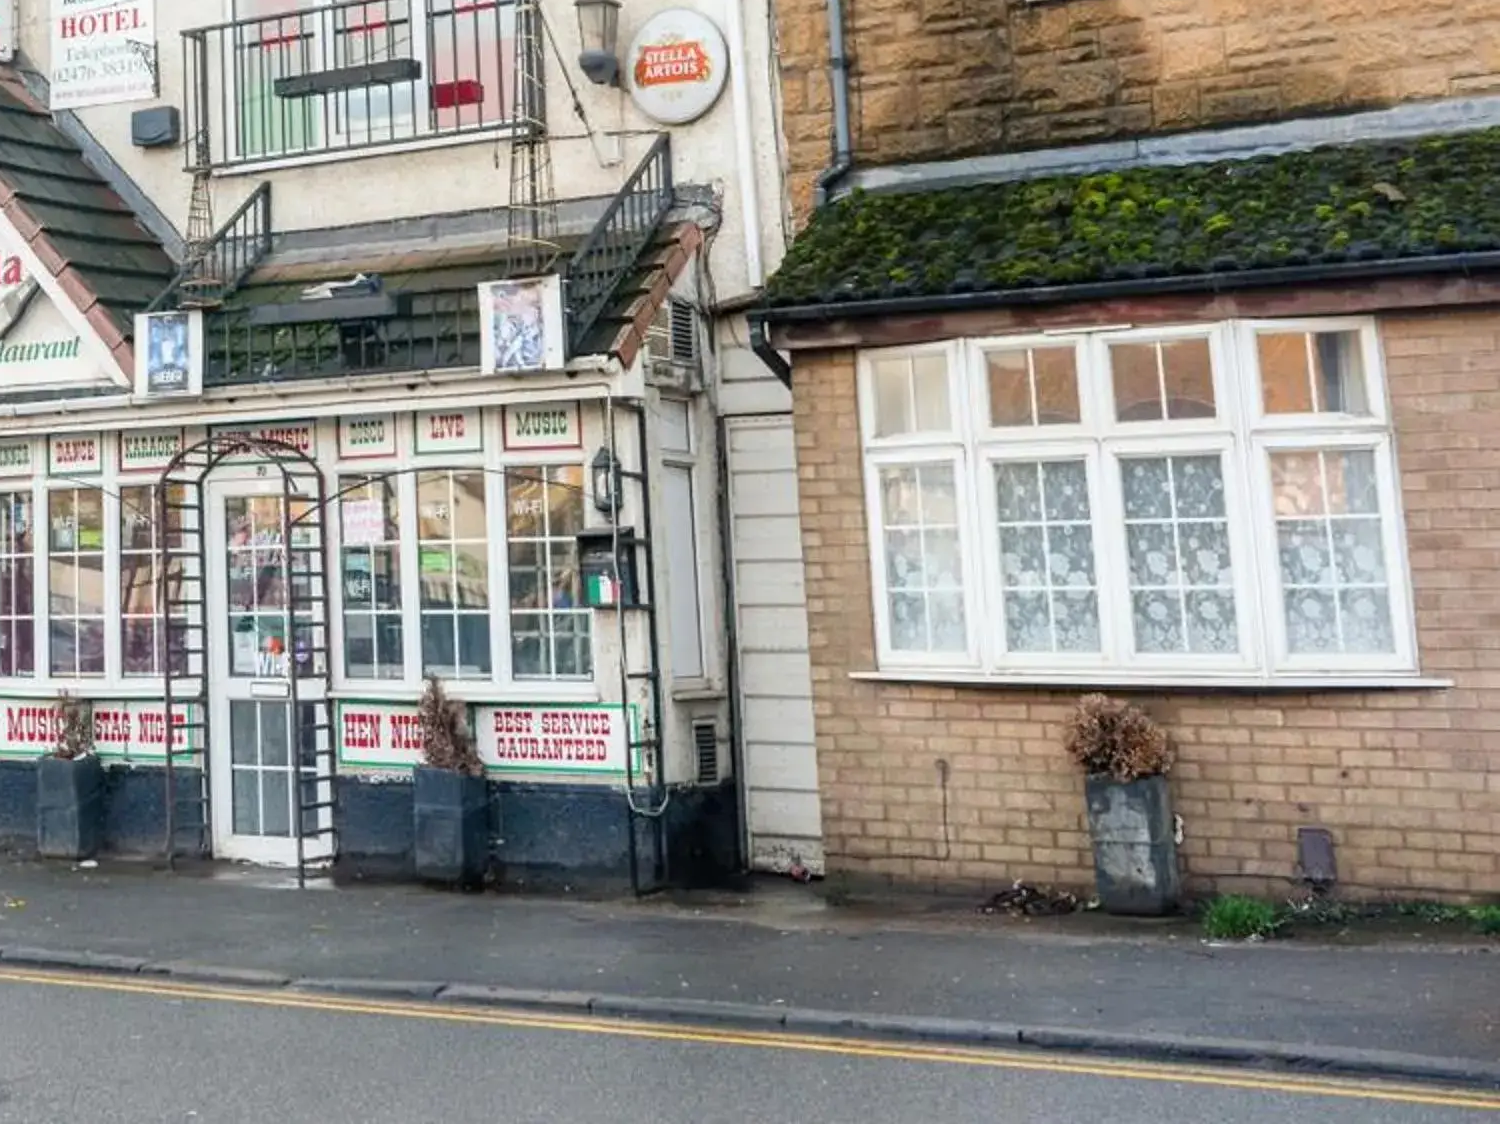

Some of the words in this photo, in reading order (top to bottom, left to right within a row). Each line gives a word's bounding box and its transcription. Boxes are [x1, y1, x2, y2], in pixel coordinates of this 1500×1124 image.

[59, 8, 147, 39] HOTEL
[67, 42, 136, 62] Telephon
[645, 47, 698, 64] STELLA
[645, 61, 698, 79] ARTOIS
[430, 414, 464, 439] LIVE
[515, 410, 568, 437] MUSIC
[55, 439, 95, 464] DANCE
[7, 707, 66, 743] MUSIC
[94, 710, 132, 743] STAG
[344, 713, 381, 749] HEN
[390, 715, 425, 749] NIG
[493, 711, 533, 733] BEST
[541, 712, 611, 735] SERVICE
